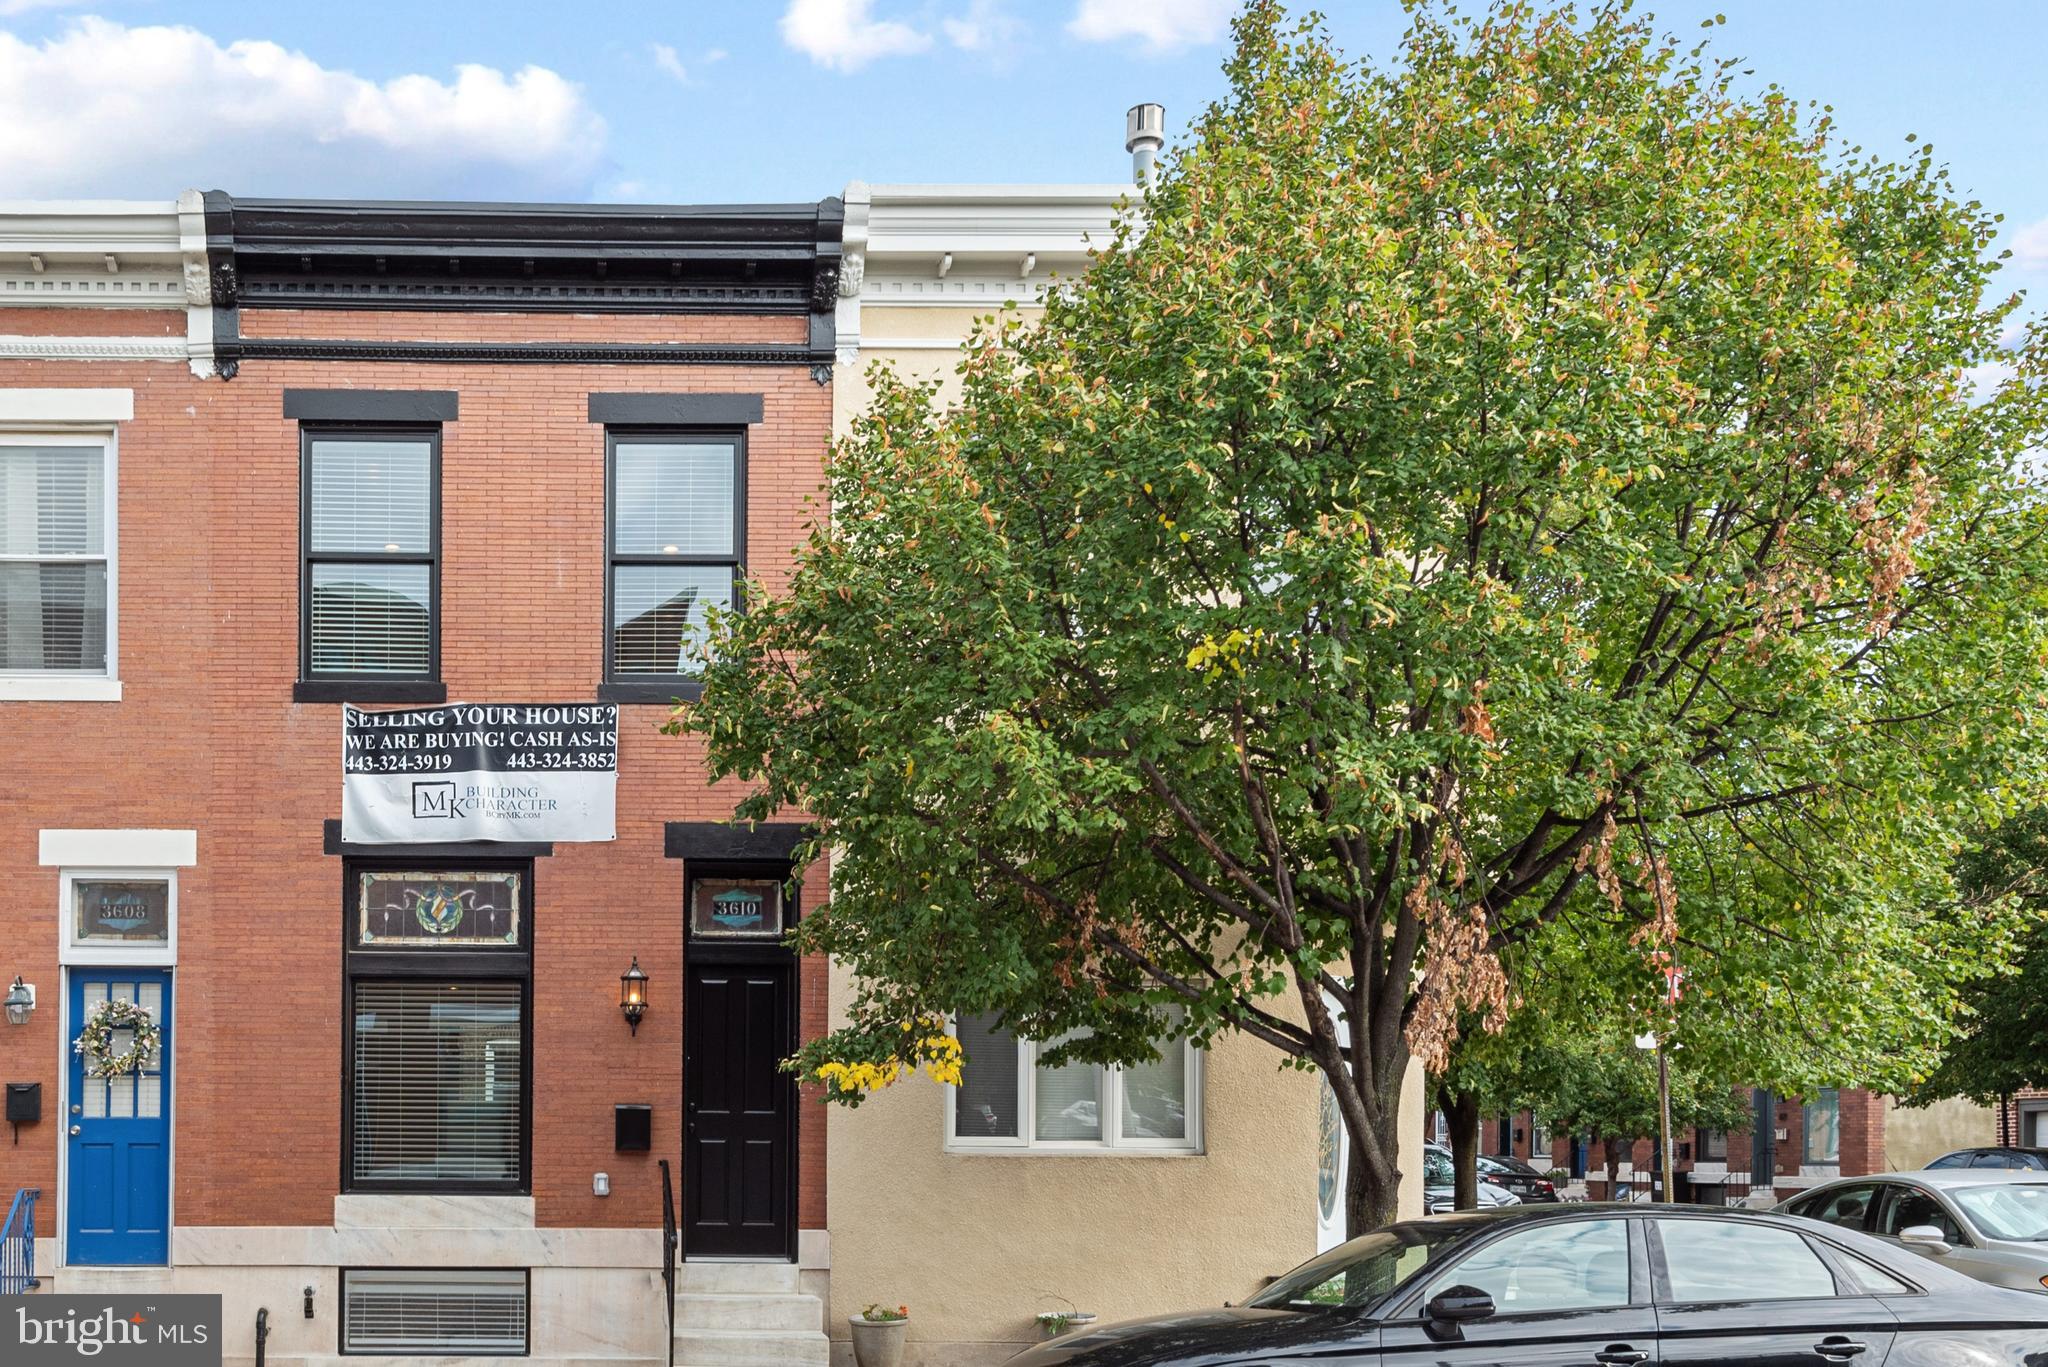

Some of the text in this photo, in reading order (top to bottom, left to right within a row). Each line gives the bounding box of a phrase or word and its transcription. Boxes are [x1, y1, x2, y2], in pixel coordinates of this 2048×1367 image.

[346, 706, 616, 728] SELLING YOUR HOUSE?
[346, 731, 616, 750] WE ARE BUYING! CASH AS-IS
[346, 754, 452, 771] 443-324-3919
[507, 752, 616, 768] 443-324-3852
[466, 786, 538, 798] BUILDING
[465, 798, 557, 811] CHARACTER
[102, 905, 145, 919] 3608
[718, 901, 756, 915] 3610
